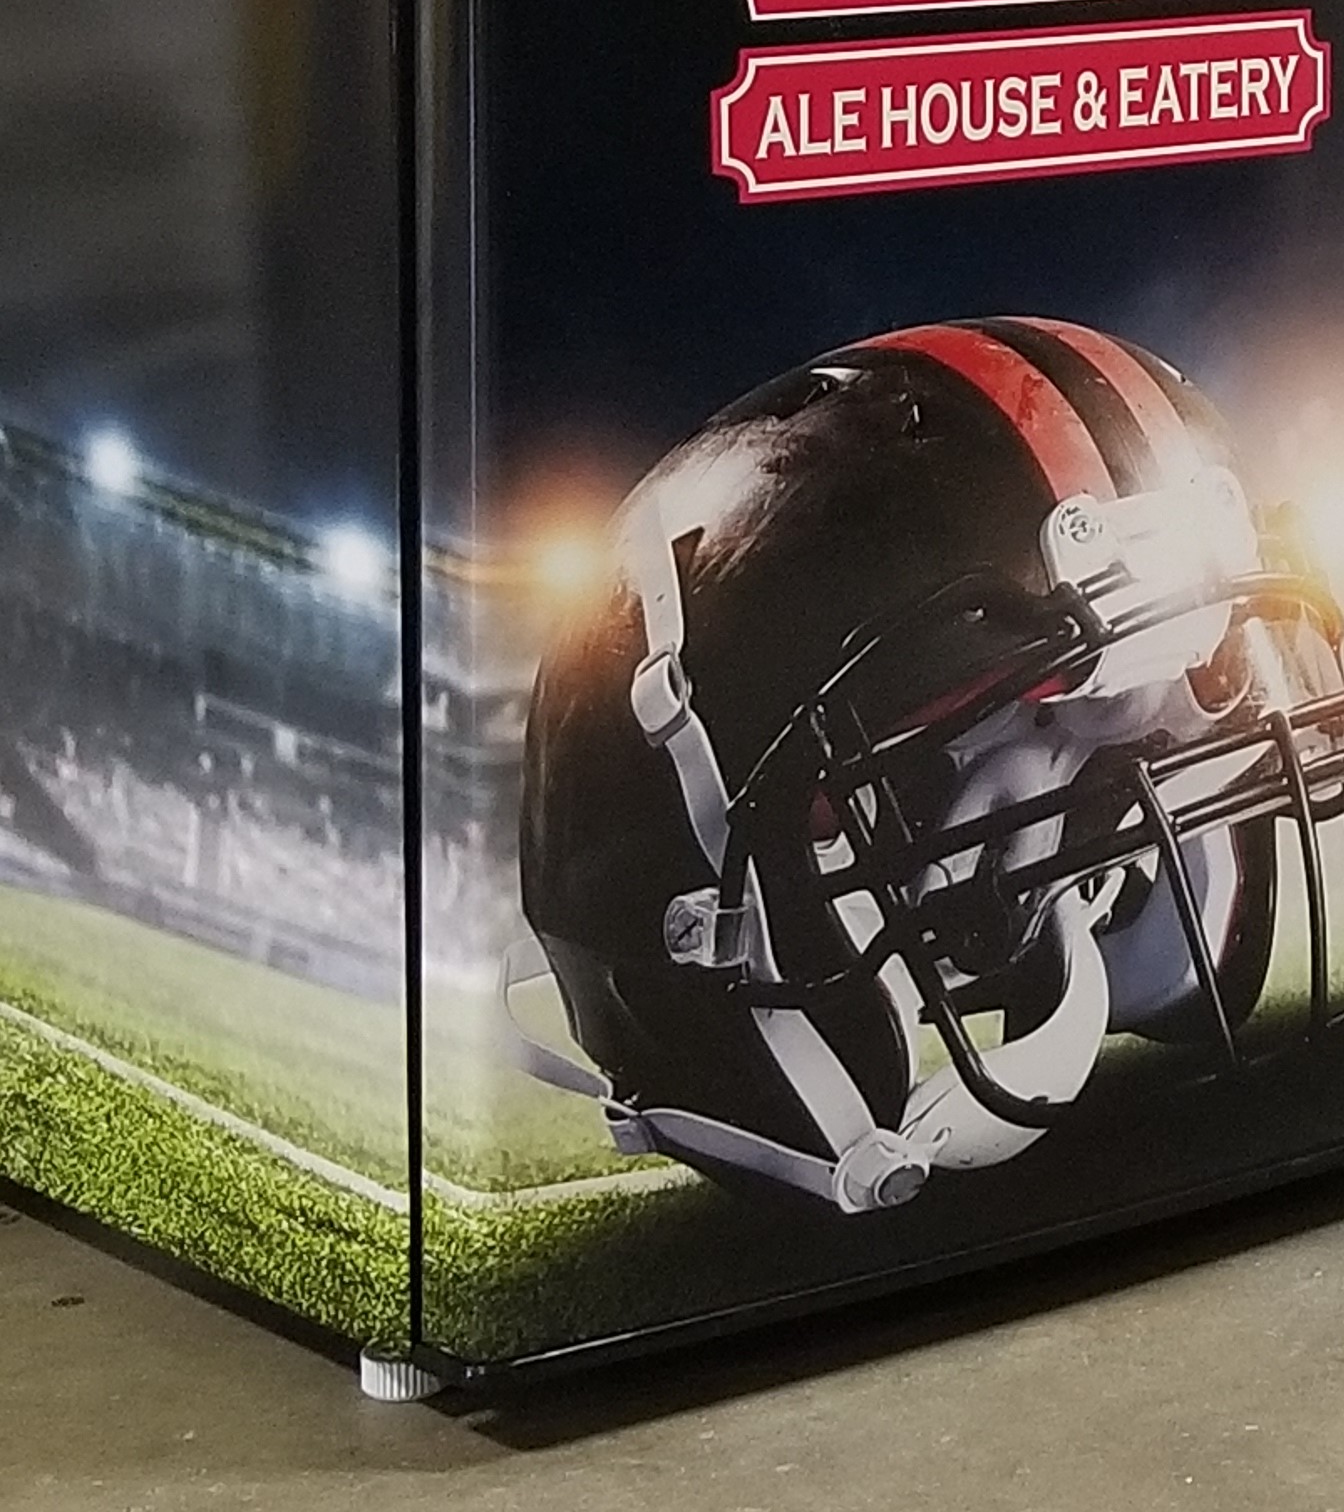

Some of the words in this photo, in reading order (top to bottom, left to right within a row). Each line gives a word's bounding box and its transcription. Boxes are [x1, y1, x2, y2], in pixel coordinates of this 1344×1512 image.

[754, 88, 867, 159] ALE
[880, 71, 1062, 148] HOUSE
[1073, 70, 1107, 130] &
[1118, 54, 1300, 128] EATERY
